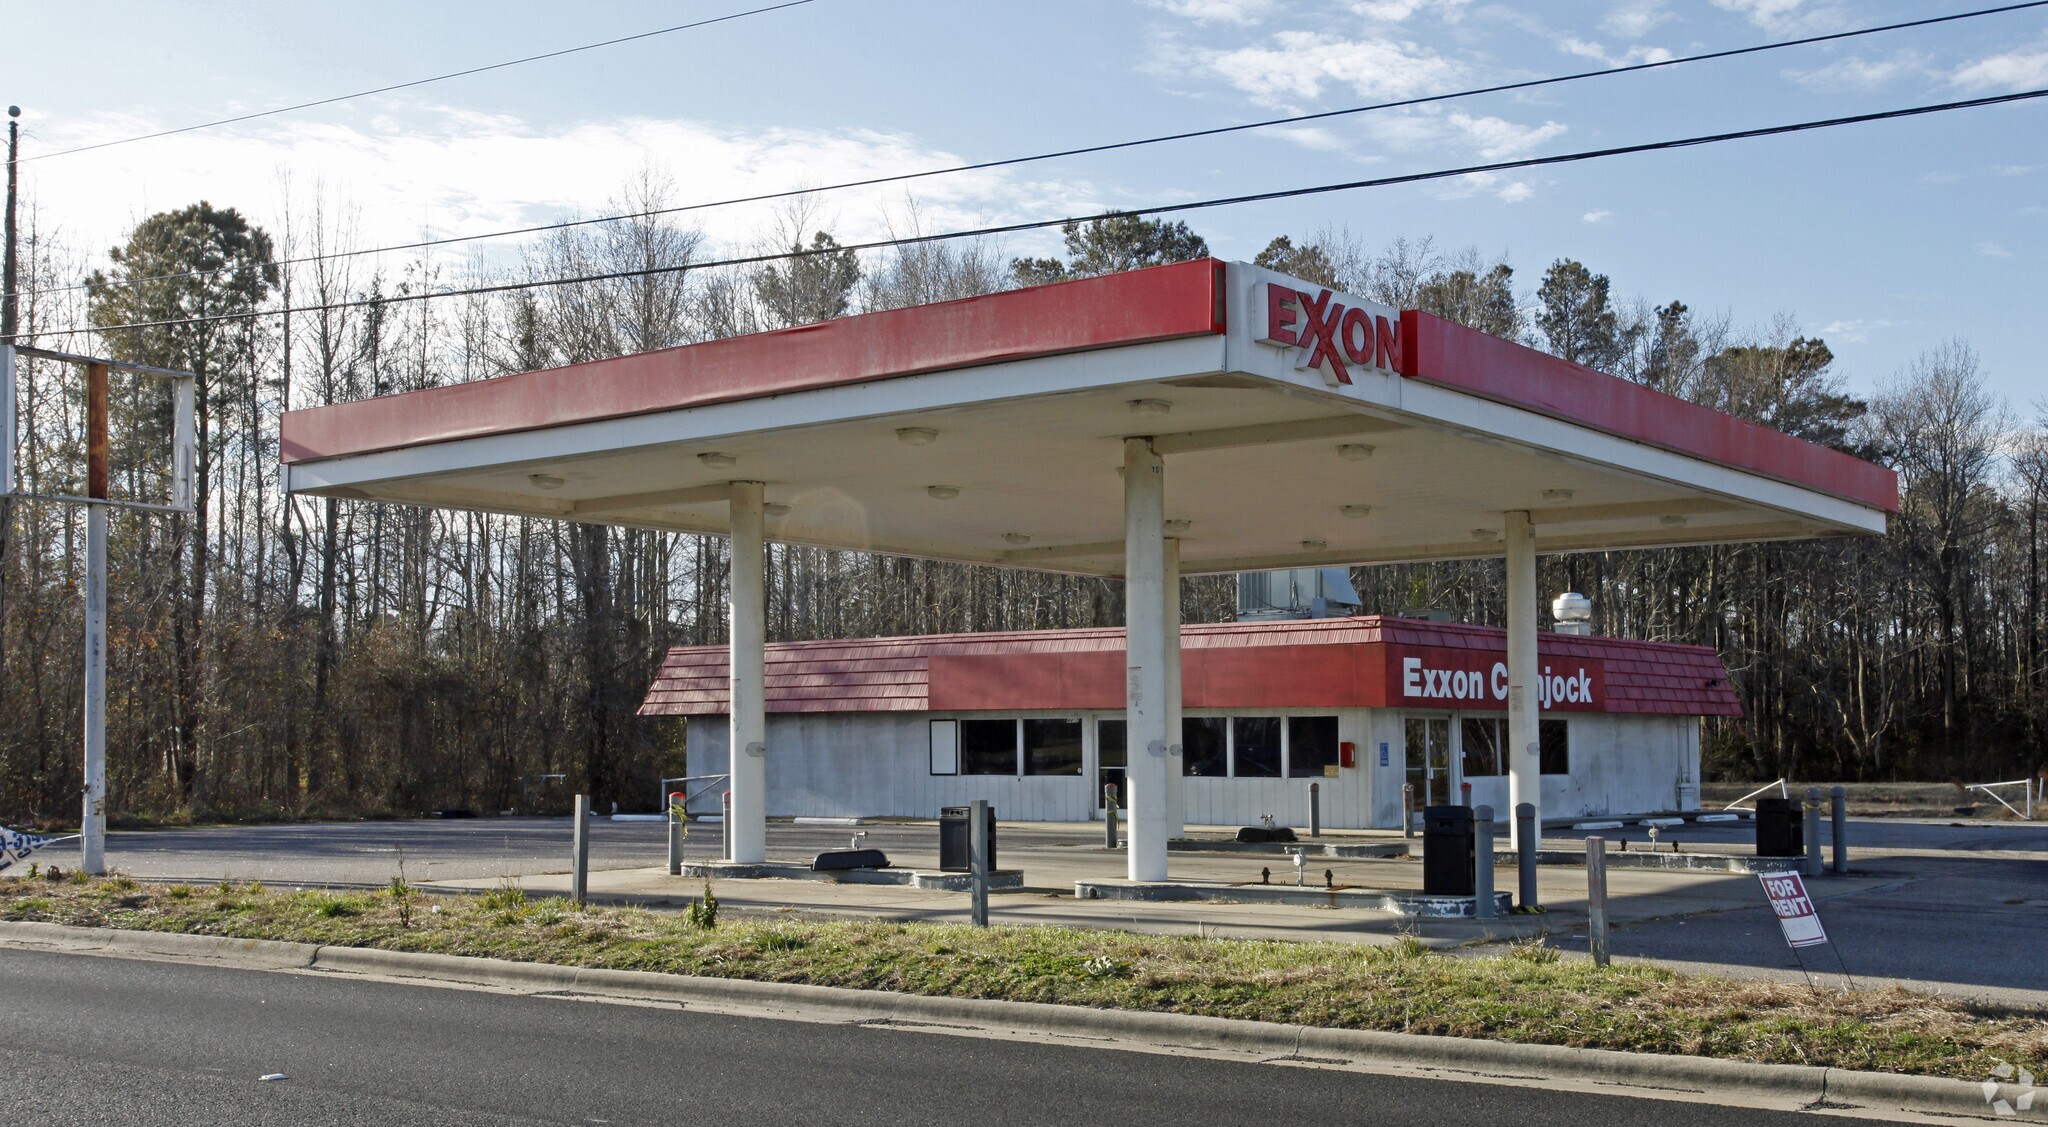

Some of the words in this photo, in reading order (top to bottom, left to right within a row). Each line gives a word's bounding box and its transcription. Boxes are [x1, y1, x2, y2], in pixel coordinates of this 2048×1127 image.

[1268, 283, 1402, 385] EXXON
[1403, 657, 1484, 699] Exxon
[1491, 662, 1592, 709] Cnjock
[1766, 879, 1797, 897] FOR
[1771, 897, 1808, 916] RENT
